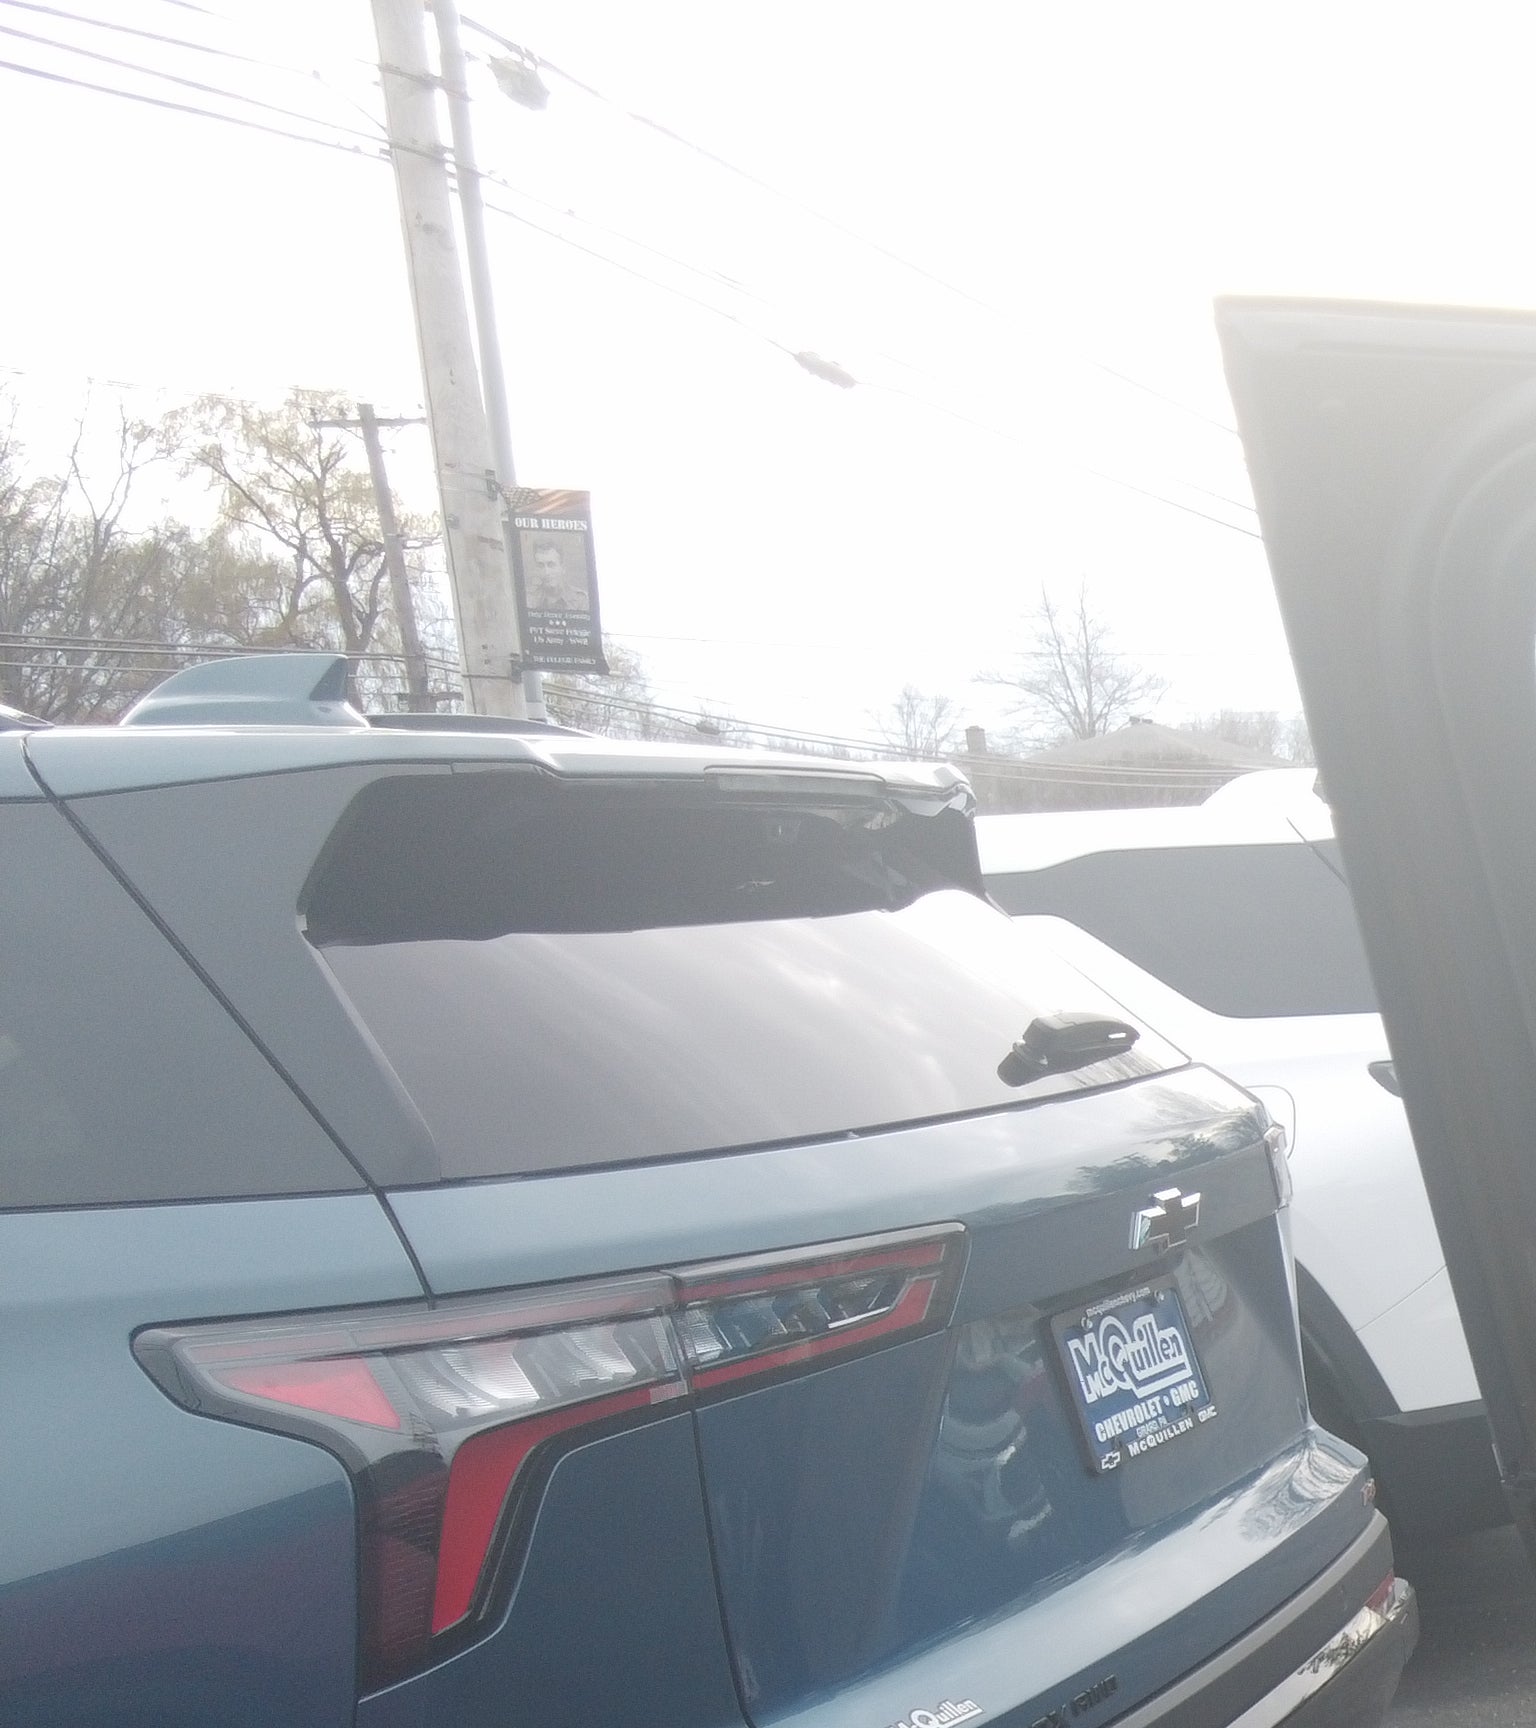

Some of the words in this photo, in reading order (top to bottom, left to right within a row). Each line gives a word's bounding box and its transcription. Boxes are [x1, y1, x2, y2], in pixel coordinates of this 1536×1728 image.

[515, 517, 539, 529] OUR
[541, 518, 588, 531] HEROES
[1068, 1314, 1193, 1404] McQuillen
[1094, 1395, 1163, 1442] CHEVROLET
[1172, 1380, 1200, 1408] GMC
[1126, 1417, 1194, 1458] McQUILLEN
